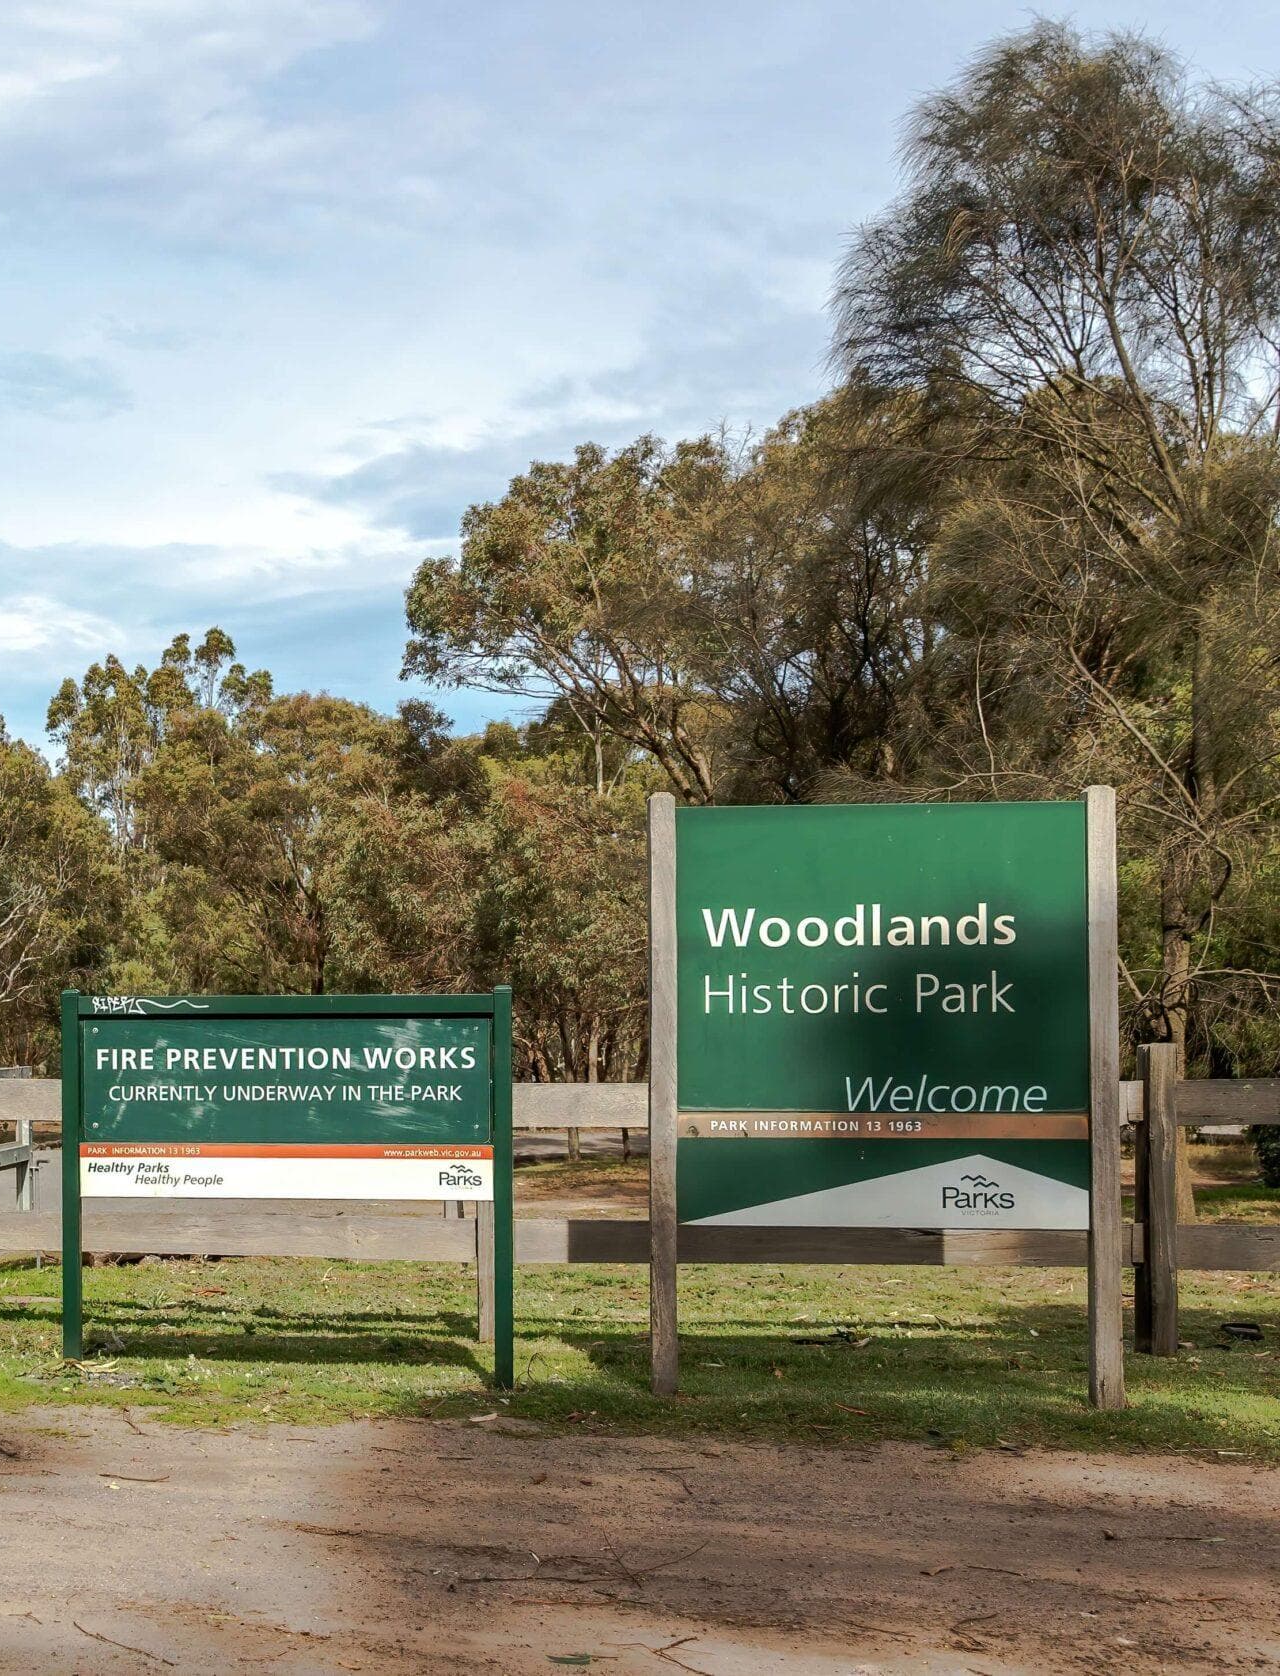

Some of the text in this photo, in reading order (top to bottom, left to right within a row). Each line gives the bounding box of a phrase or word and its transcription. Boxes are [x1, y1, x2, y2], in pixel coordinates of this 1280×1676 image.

[702, 903, 1016, 947] Woodlands
[704, 971, 1016, 1014] Historic Park
[96, 1046, 476, 1070] FIRE PREVENTION WORKS
[108, 1084, 463, 1102] CURRENTLY UNDERWAY IN THE PARK
[844, 1074, 1048, 1113] Welcome
[710, 1120, 922, 1132] PARK INFORMATION 13 1963
[87, 1147, 201, 1155] PARK INFORMATION 13 1963
[383, 1148, 482, 1158] www.parkweb.vic.gov.au
[87, 1162, 170, 1175] Healthy Parks
[135, 1174, 224, 1188] Healthy People
[439, 1171, 483, 1187] Parks
[942, 1186, 1015, 1209] Parks
